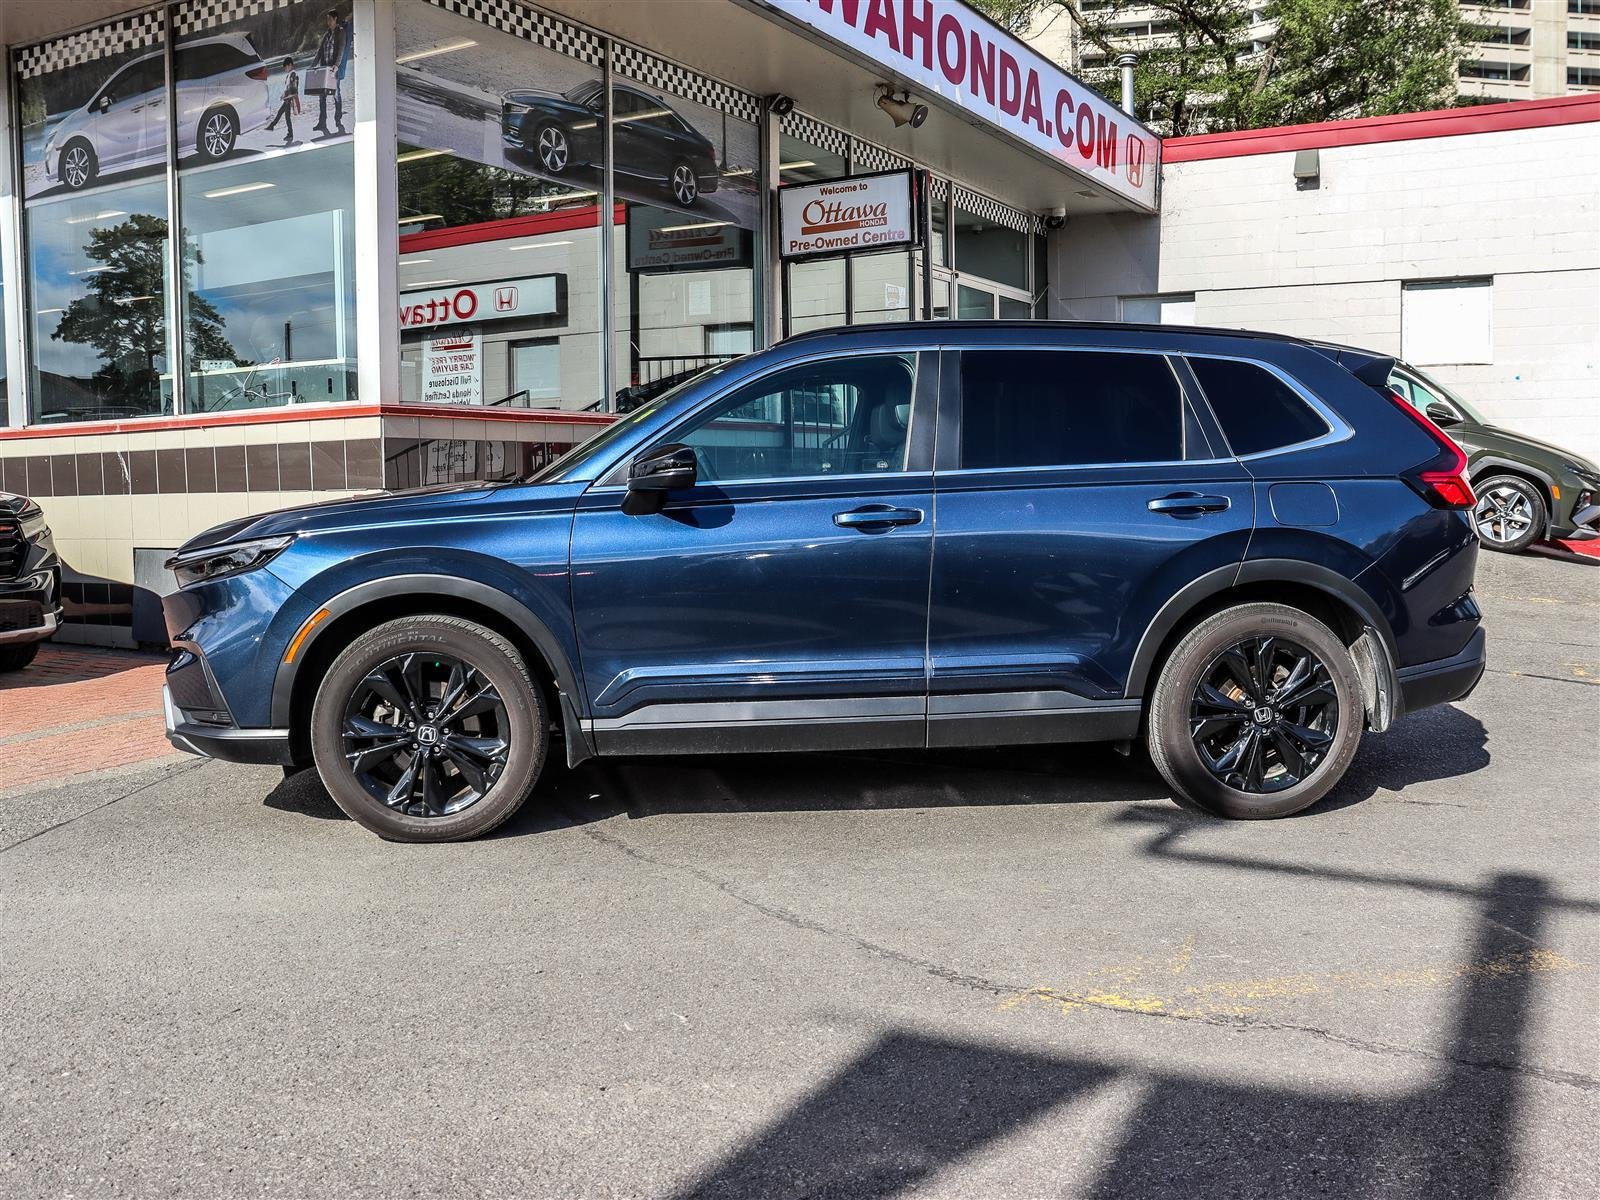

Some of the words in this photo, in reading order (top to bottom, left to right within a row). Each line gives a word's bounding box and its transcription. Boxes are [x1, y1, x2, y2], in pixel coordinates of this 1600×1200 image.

[819, 184, 857, 196] Welcome
[859, 182, 868, 191] to
[802, 199, 888, 226] Ottawa
[859, 217, 885, 229] HONDA
[789, 232, 859, 252] Pre-Owned
[862, 229, 905, 244] Centre
